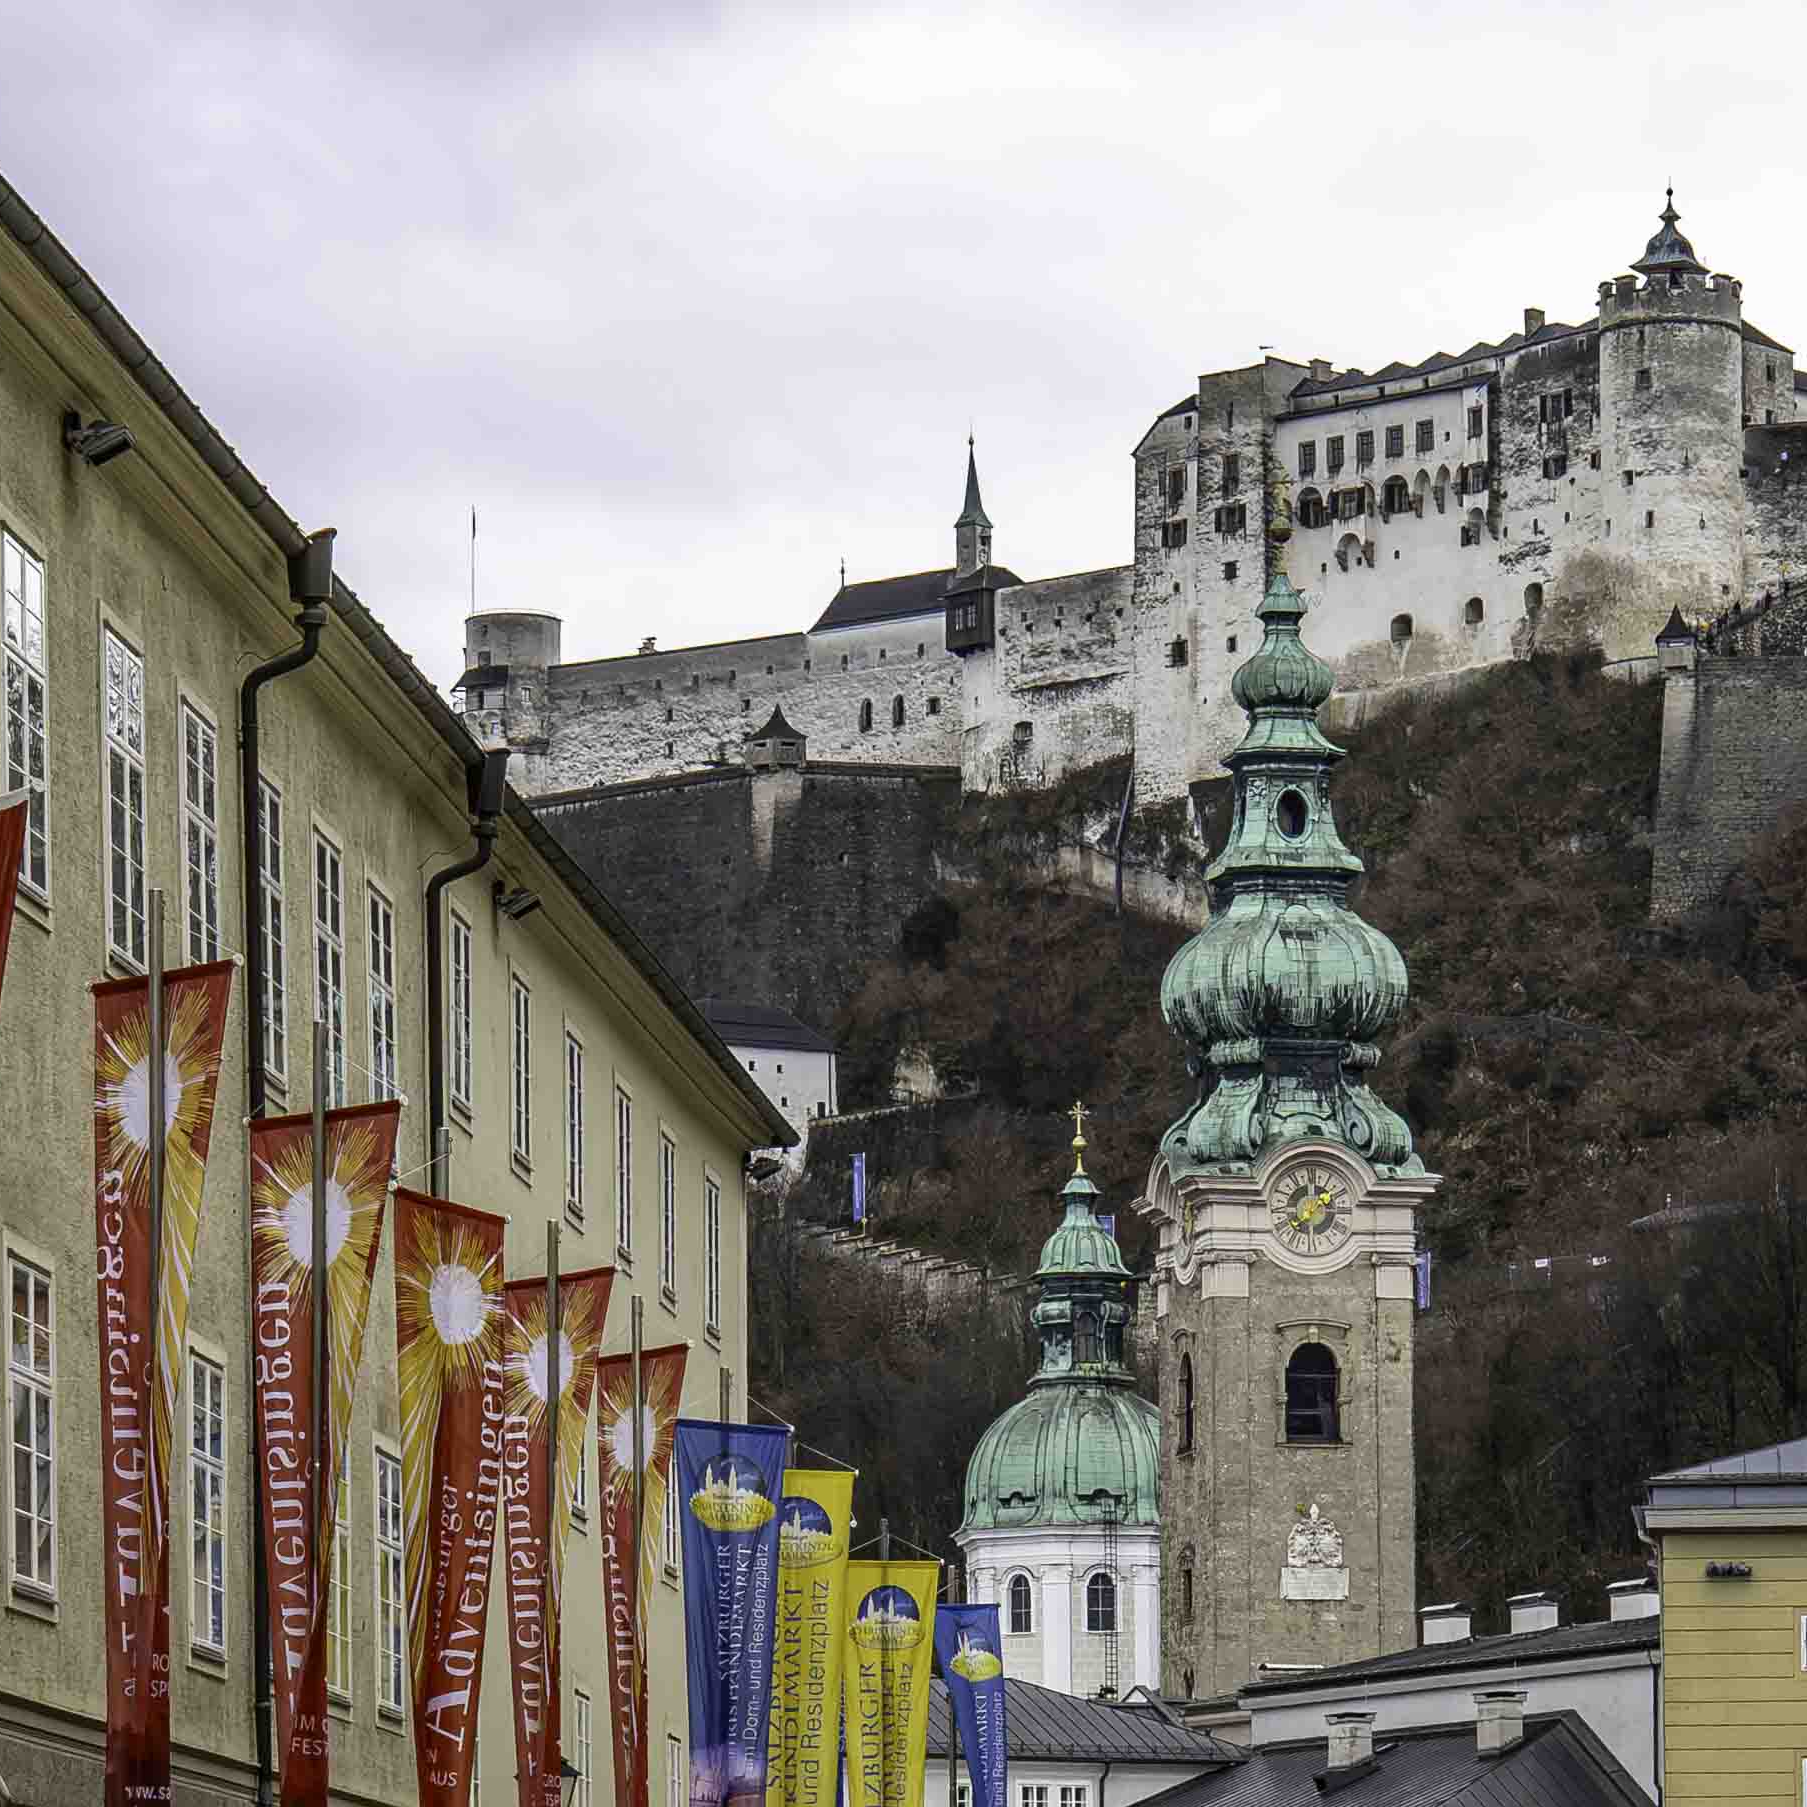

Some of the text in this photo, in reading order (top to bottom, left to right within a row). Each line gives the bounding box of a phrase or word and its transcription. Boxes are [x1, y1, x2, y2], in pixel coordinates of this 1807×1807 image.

[426, 1359, 506, 1753] Adventsingen
[747, 1543, 770, 1654] Residenzplatz
[746, 1659, 762, 1690] und
[801, 1580, 830, 1750] Residenzplatz
[742, 1695, 759, 1740] Dom-
[801, 1759, 820, 1805] und
[993, 1781, 1004, 1806] und
